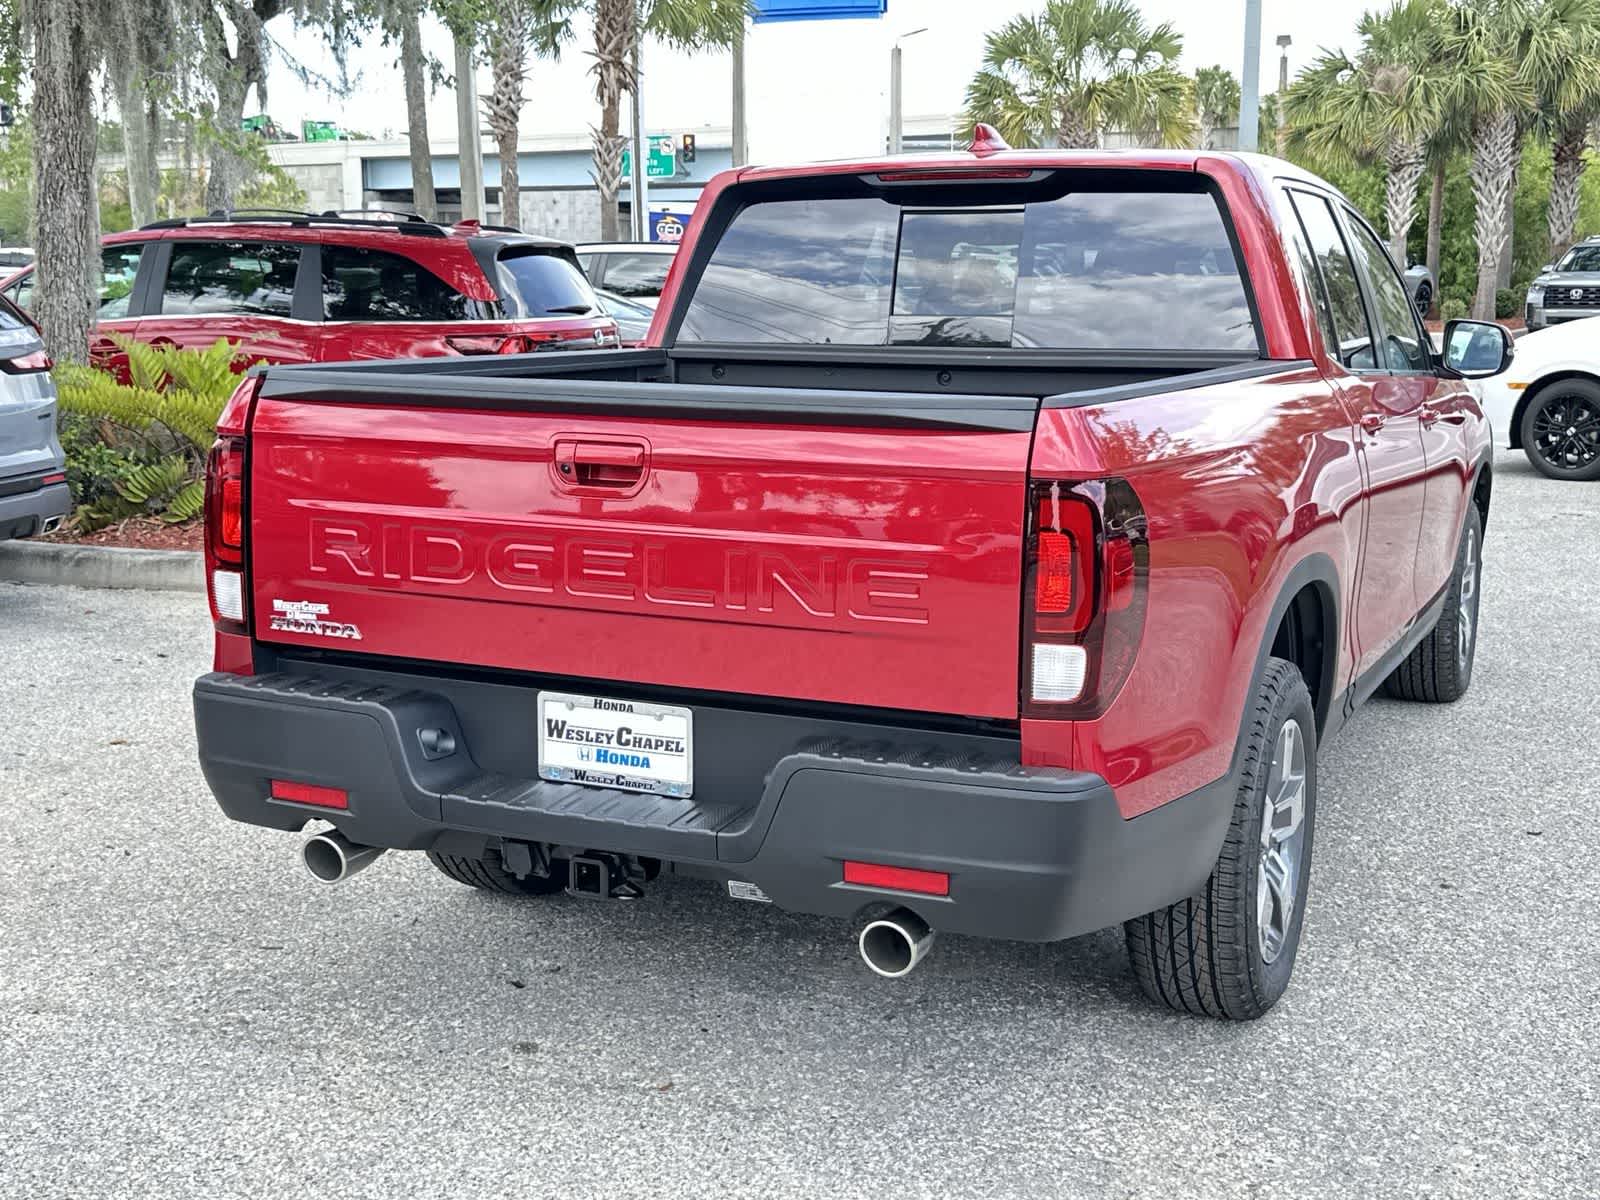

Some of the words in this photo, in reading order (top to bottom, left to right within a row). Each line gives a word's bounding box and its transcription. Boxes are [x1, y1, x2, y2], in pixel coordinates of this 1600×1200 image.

[308, 515, 932, 625] RIDGELINE
[593, 698, 634, 713] HONDA
[546, 718, 615, 745] WESLEY
[616, 726, 685, 753] CHAPEL
[595, 748, 651, 769] HONDA
[573, 769, 615, 785] WESLEY
[615, 775, 655, 791] CHAPEL
